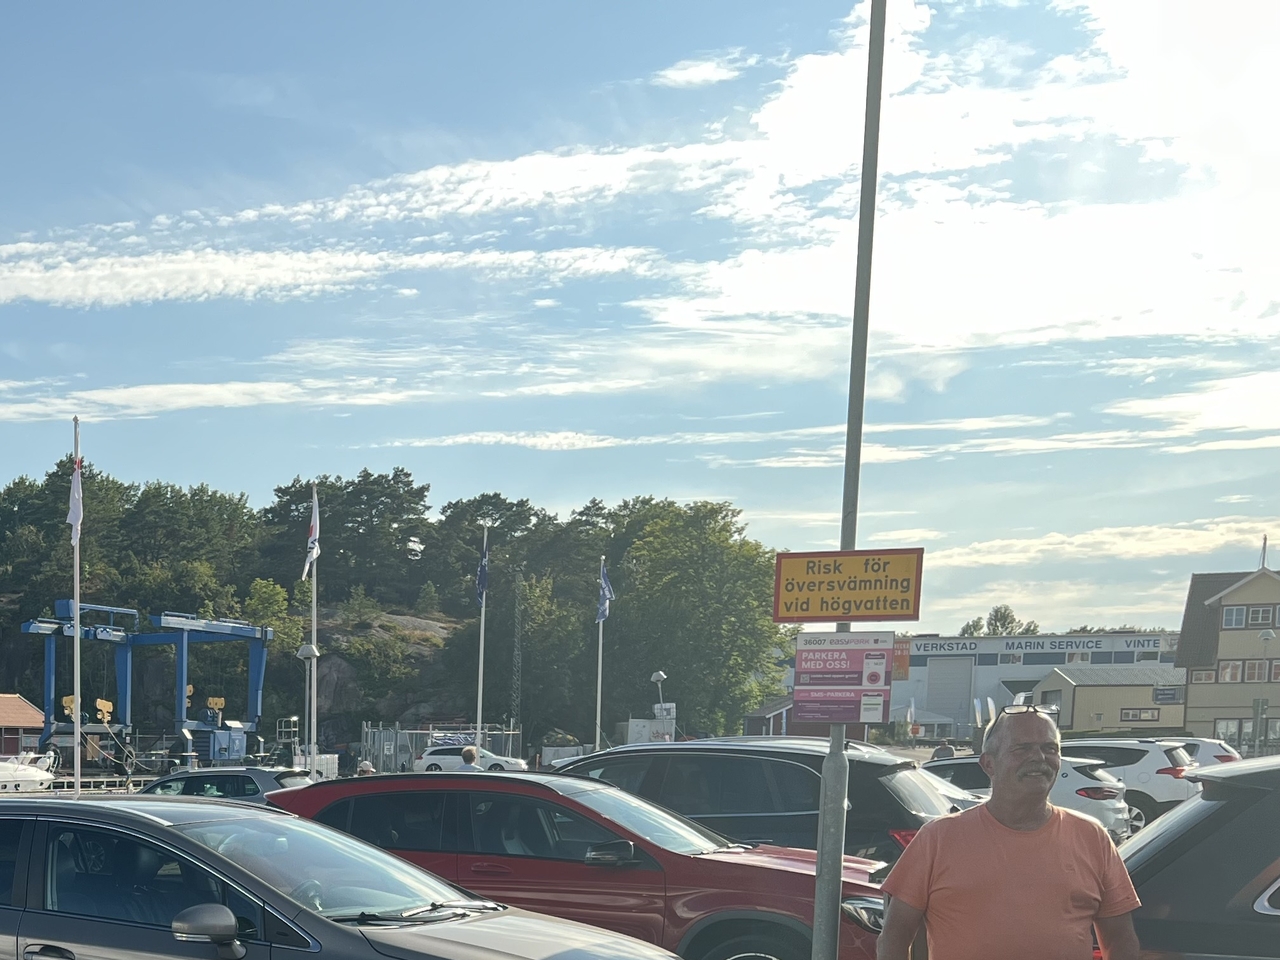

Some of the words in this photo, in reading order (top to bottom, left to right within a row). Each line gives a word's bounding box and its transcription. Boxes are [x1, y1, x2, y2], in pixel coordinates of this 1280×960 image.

[806, 559, 843, 575] Risk
[864, 557, 891, 573] för
[784, 575, 911, 594] översvämning
[784, 597, 810, 612] vid
[820, 595, 911, 615] högvatten
[803, 638, 827, 646] 36007
[915, 642, 978, 652] VERKSTAD
[1005, 641, 1045, 651] MARIN
[1049, 640, 1103, 650] SERVICE
[1125, 639, 1160, 649] VINTE
[802, 651, 847, 660] PARKERA
[801, 660, 824, 669] MED
[826, 660, 850, 669] OSS!
